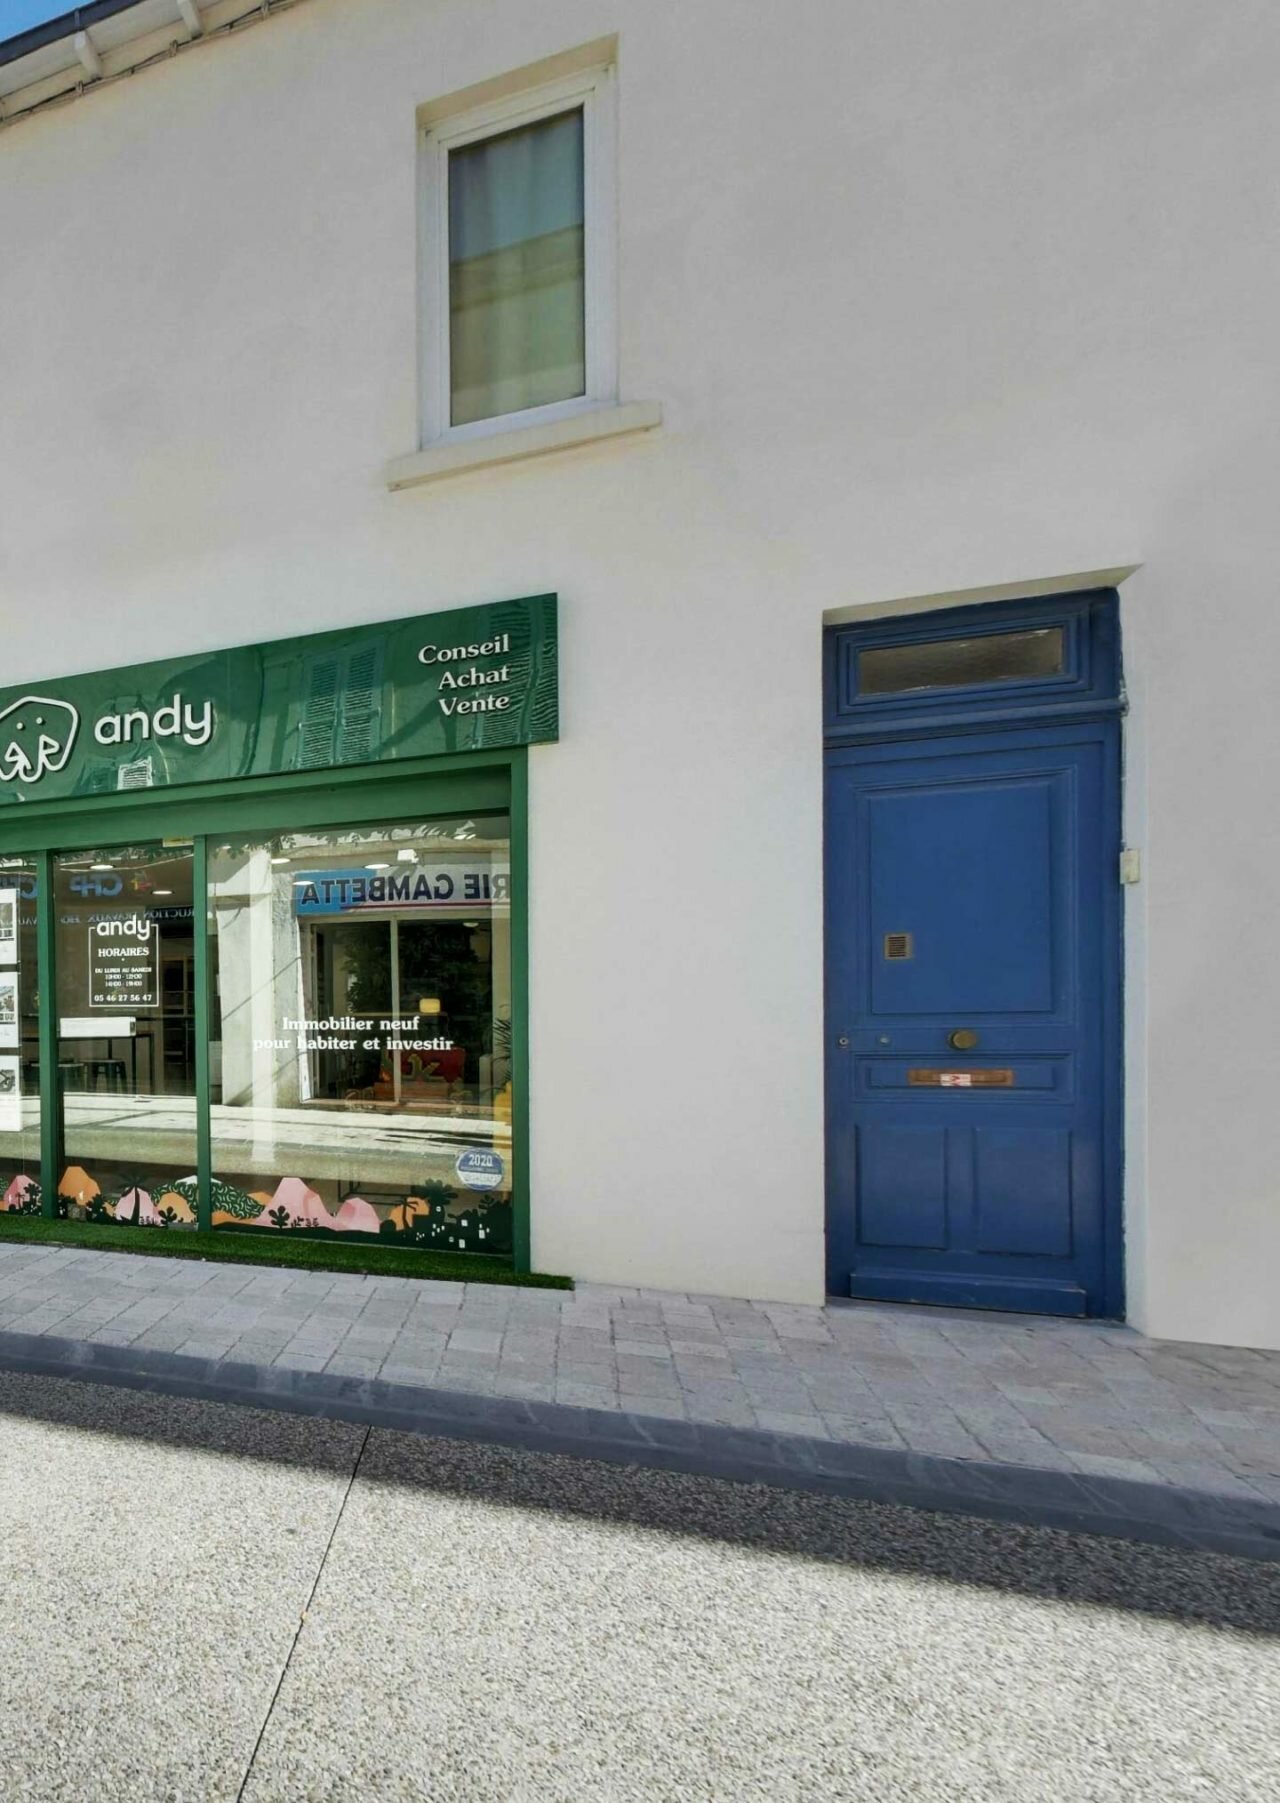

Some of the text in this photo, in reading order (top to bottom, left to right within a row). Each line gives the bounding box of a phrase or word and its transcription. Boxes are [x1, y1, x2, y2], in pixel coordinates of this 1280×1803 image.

[418, 633, 510, 664] Conseil
[437, 665, 510, 690] Achat
[438, 694, 510, 716] Vente
[94, 693, 212, 746] andy
[96, 914, 150, 941] andy
[98, 947, 150, 958] HORAIRES
[94, 994, 104, 1002] 05
[106, 994, 117, 1002] 46
[118, 994, 128, 1002] 27
[142, 994, 152, 1002] 47
[282, 1016, 421, 1031] Immobilier neuf
[252, 1036, 455, 1052] pour habiter et investir
[468, 1154, 494, 1167] 2020
